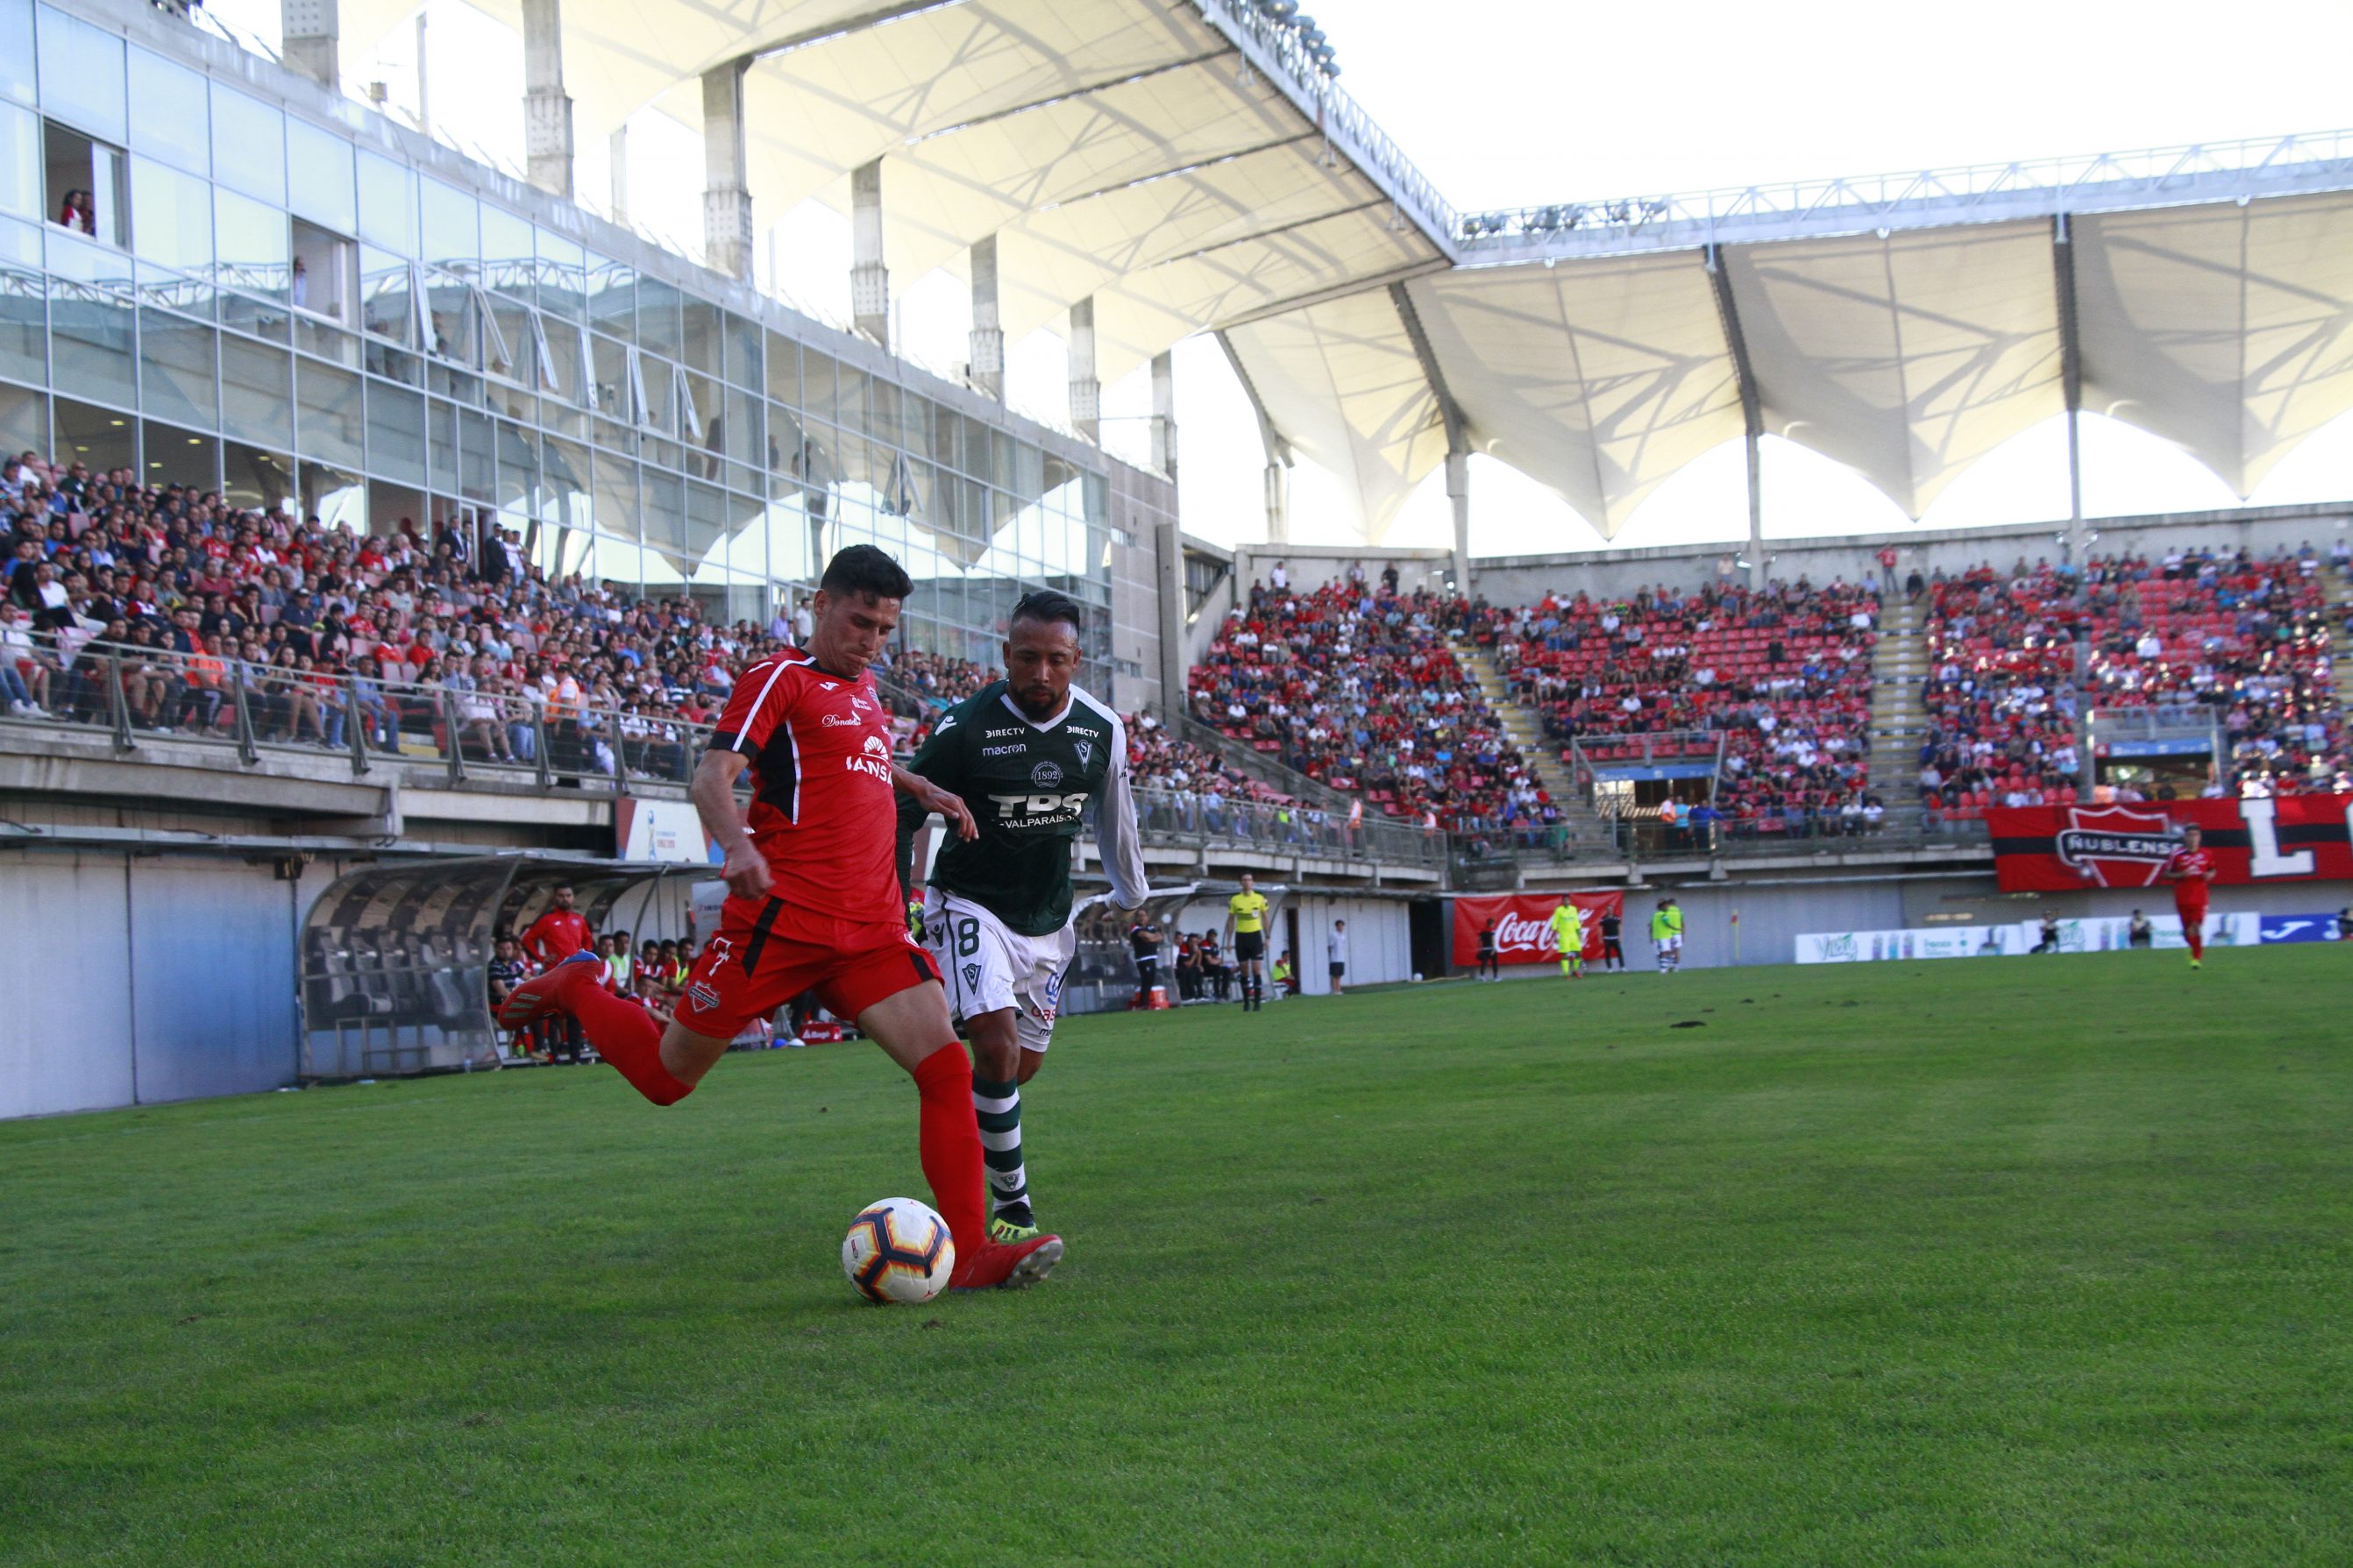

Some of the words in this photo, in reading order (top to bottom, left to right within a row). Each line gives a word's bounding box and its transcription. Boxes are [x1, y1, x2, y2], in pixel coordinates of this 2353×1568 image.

[985, 727, 1026, 739] DIRECTV
[1066, 726, 1099, 737] DIRECTV
[983, 744, 1027, 756] macron
[1037, 770, 1058, 780] 1892
[958, 918, 980, 957] 8
[708, 936, 734, 977] 7
